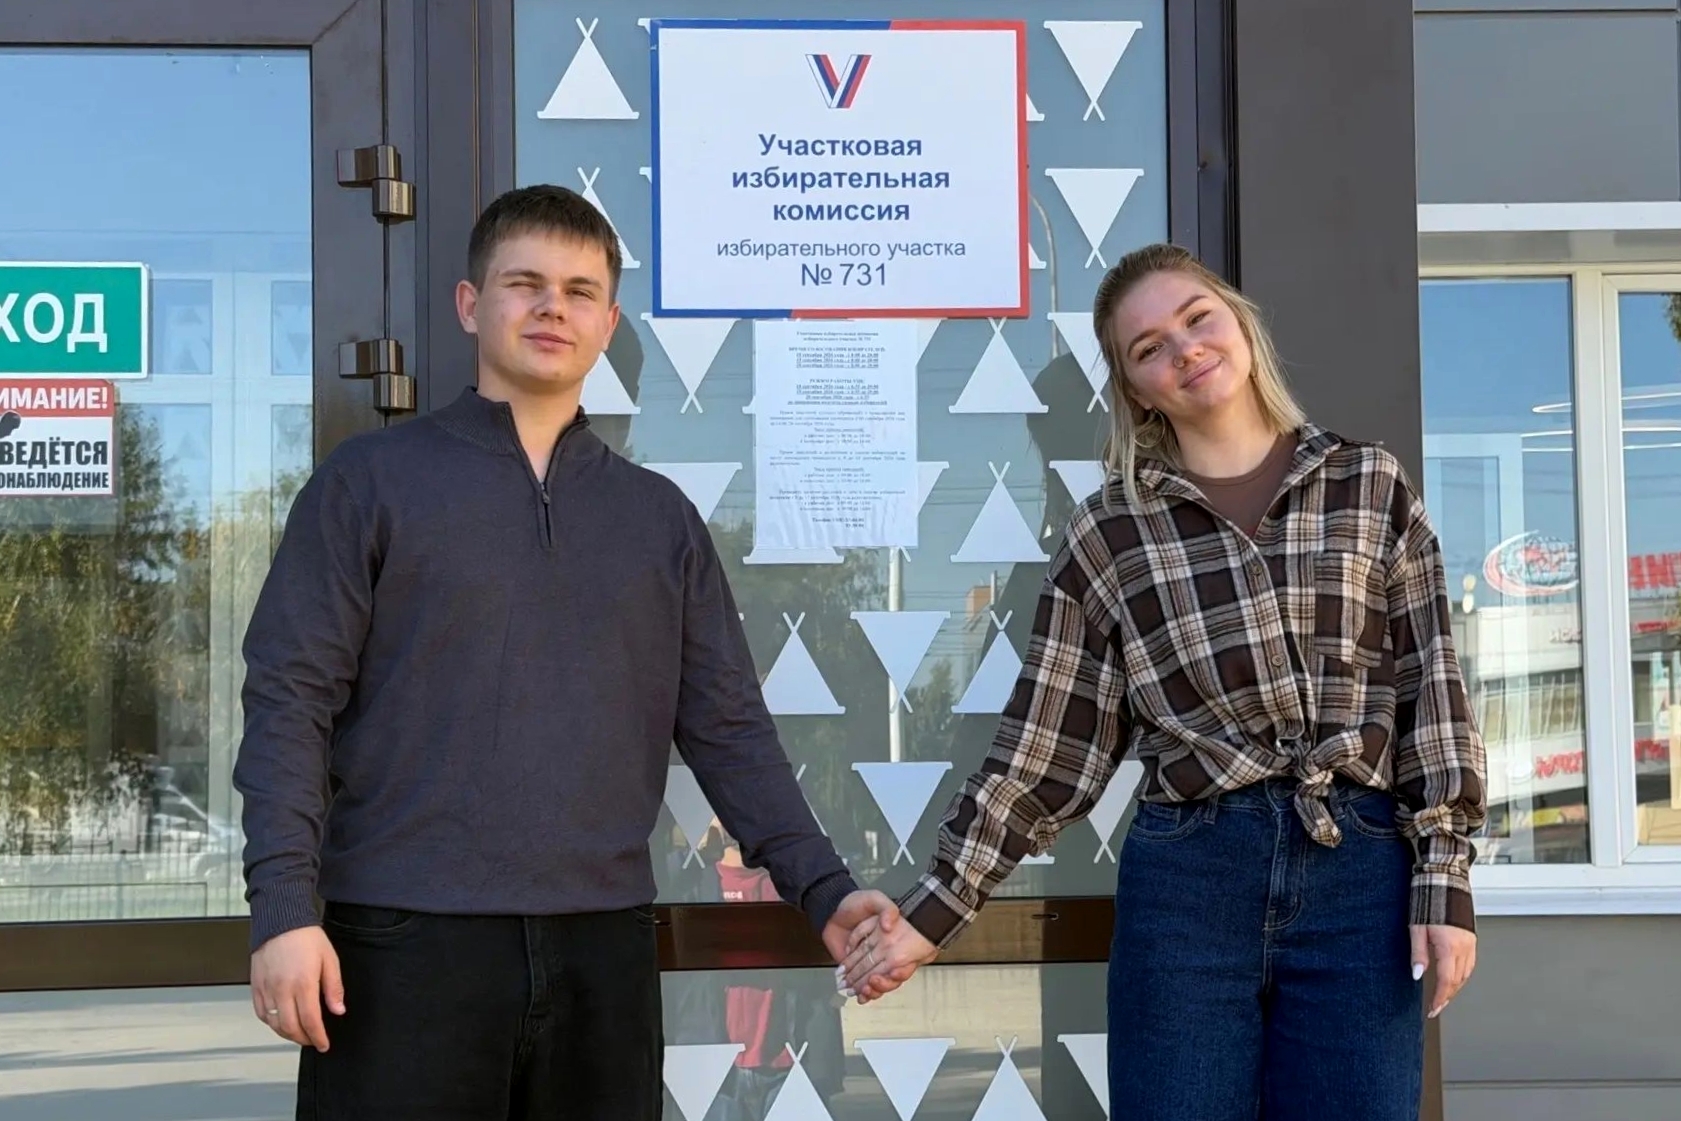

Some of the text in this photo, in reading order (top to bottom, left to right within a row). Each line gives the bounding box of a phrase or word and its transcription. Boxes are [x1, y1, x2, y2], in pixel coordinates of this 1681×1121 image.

[758, 133, 922, 157] Участковая
[732, 166, 950, 193] избирательная
[773, 203, 910, 221] комиссия
[717, 239, 966, 260] избирательного участка
[839, 263, 886, 286] 731
[0, 436, 108, 469] ВЕДЁТСЯ
